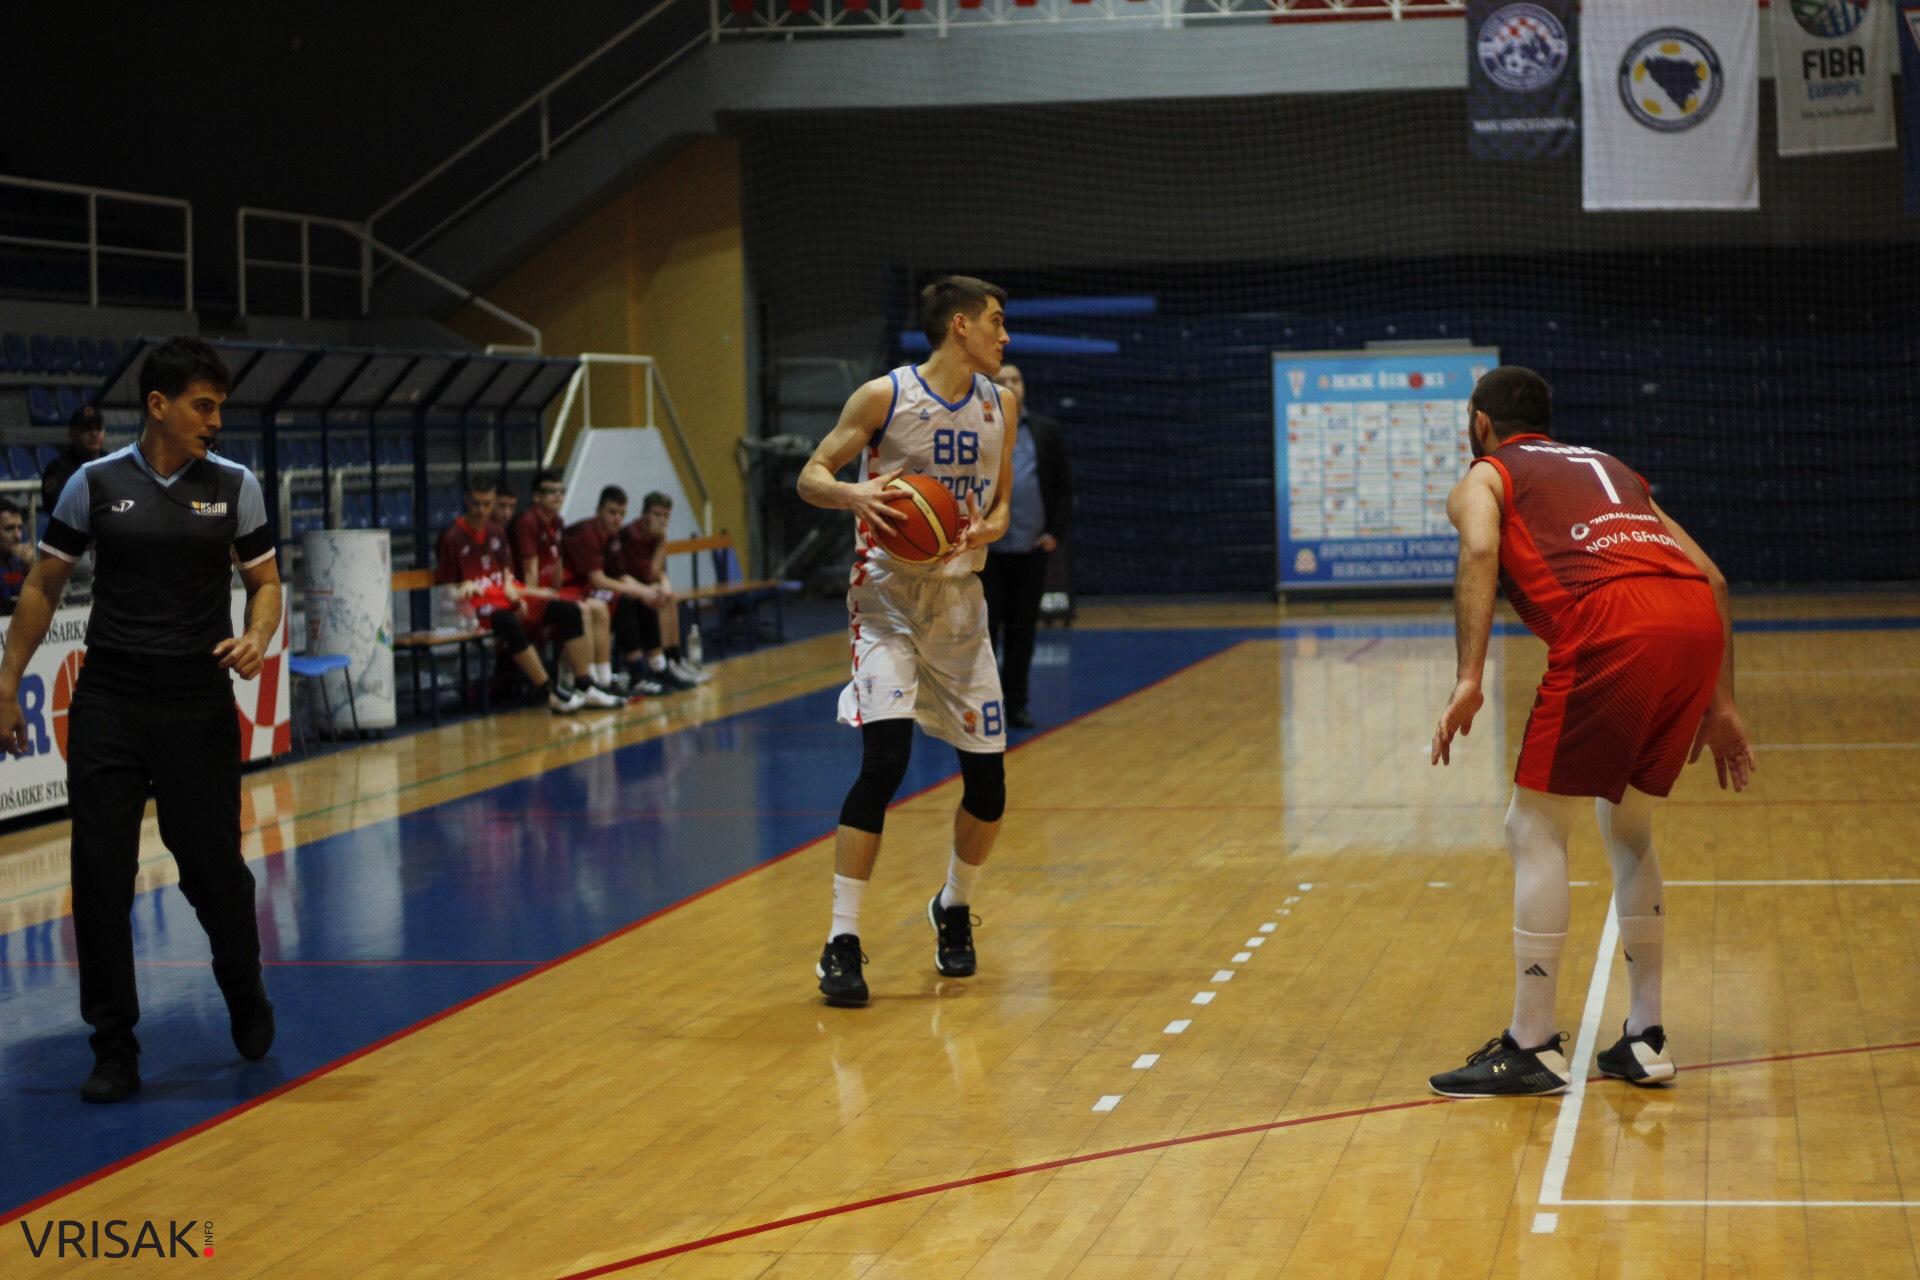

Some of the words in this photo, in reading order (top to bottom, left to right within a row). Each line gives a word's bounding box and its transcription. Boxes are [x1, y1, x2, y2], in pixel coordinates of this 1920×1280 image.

[1802, 45, 1866, 80] FIBA
[934, 429, 979, 465] 88
[1566, 456, 1621, 504] 7
[1585, 532, 1630, 552] NOVA
[0, 785, 44, 809] OŠARKE
[46, 780, 68, 801] STA
